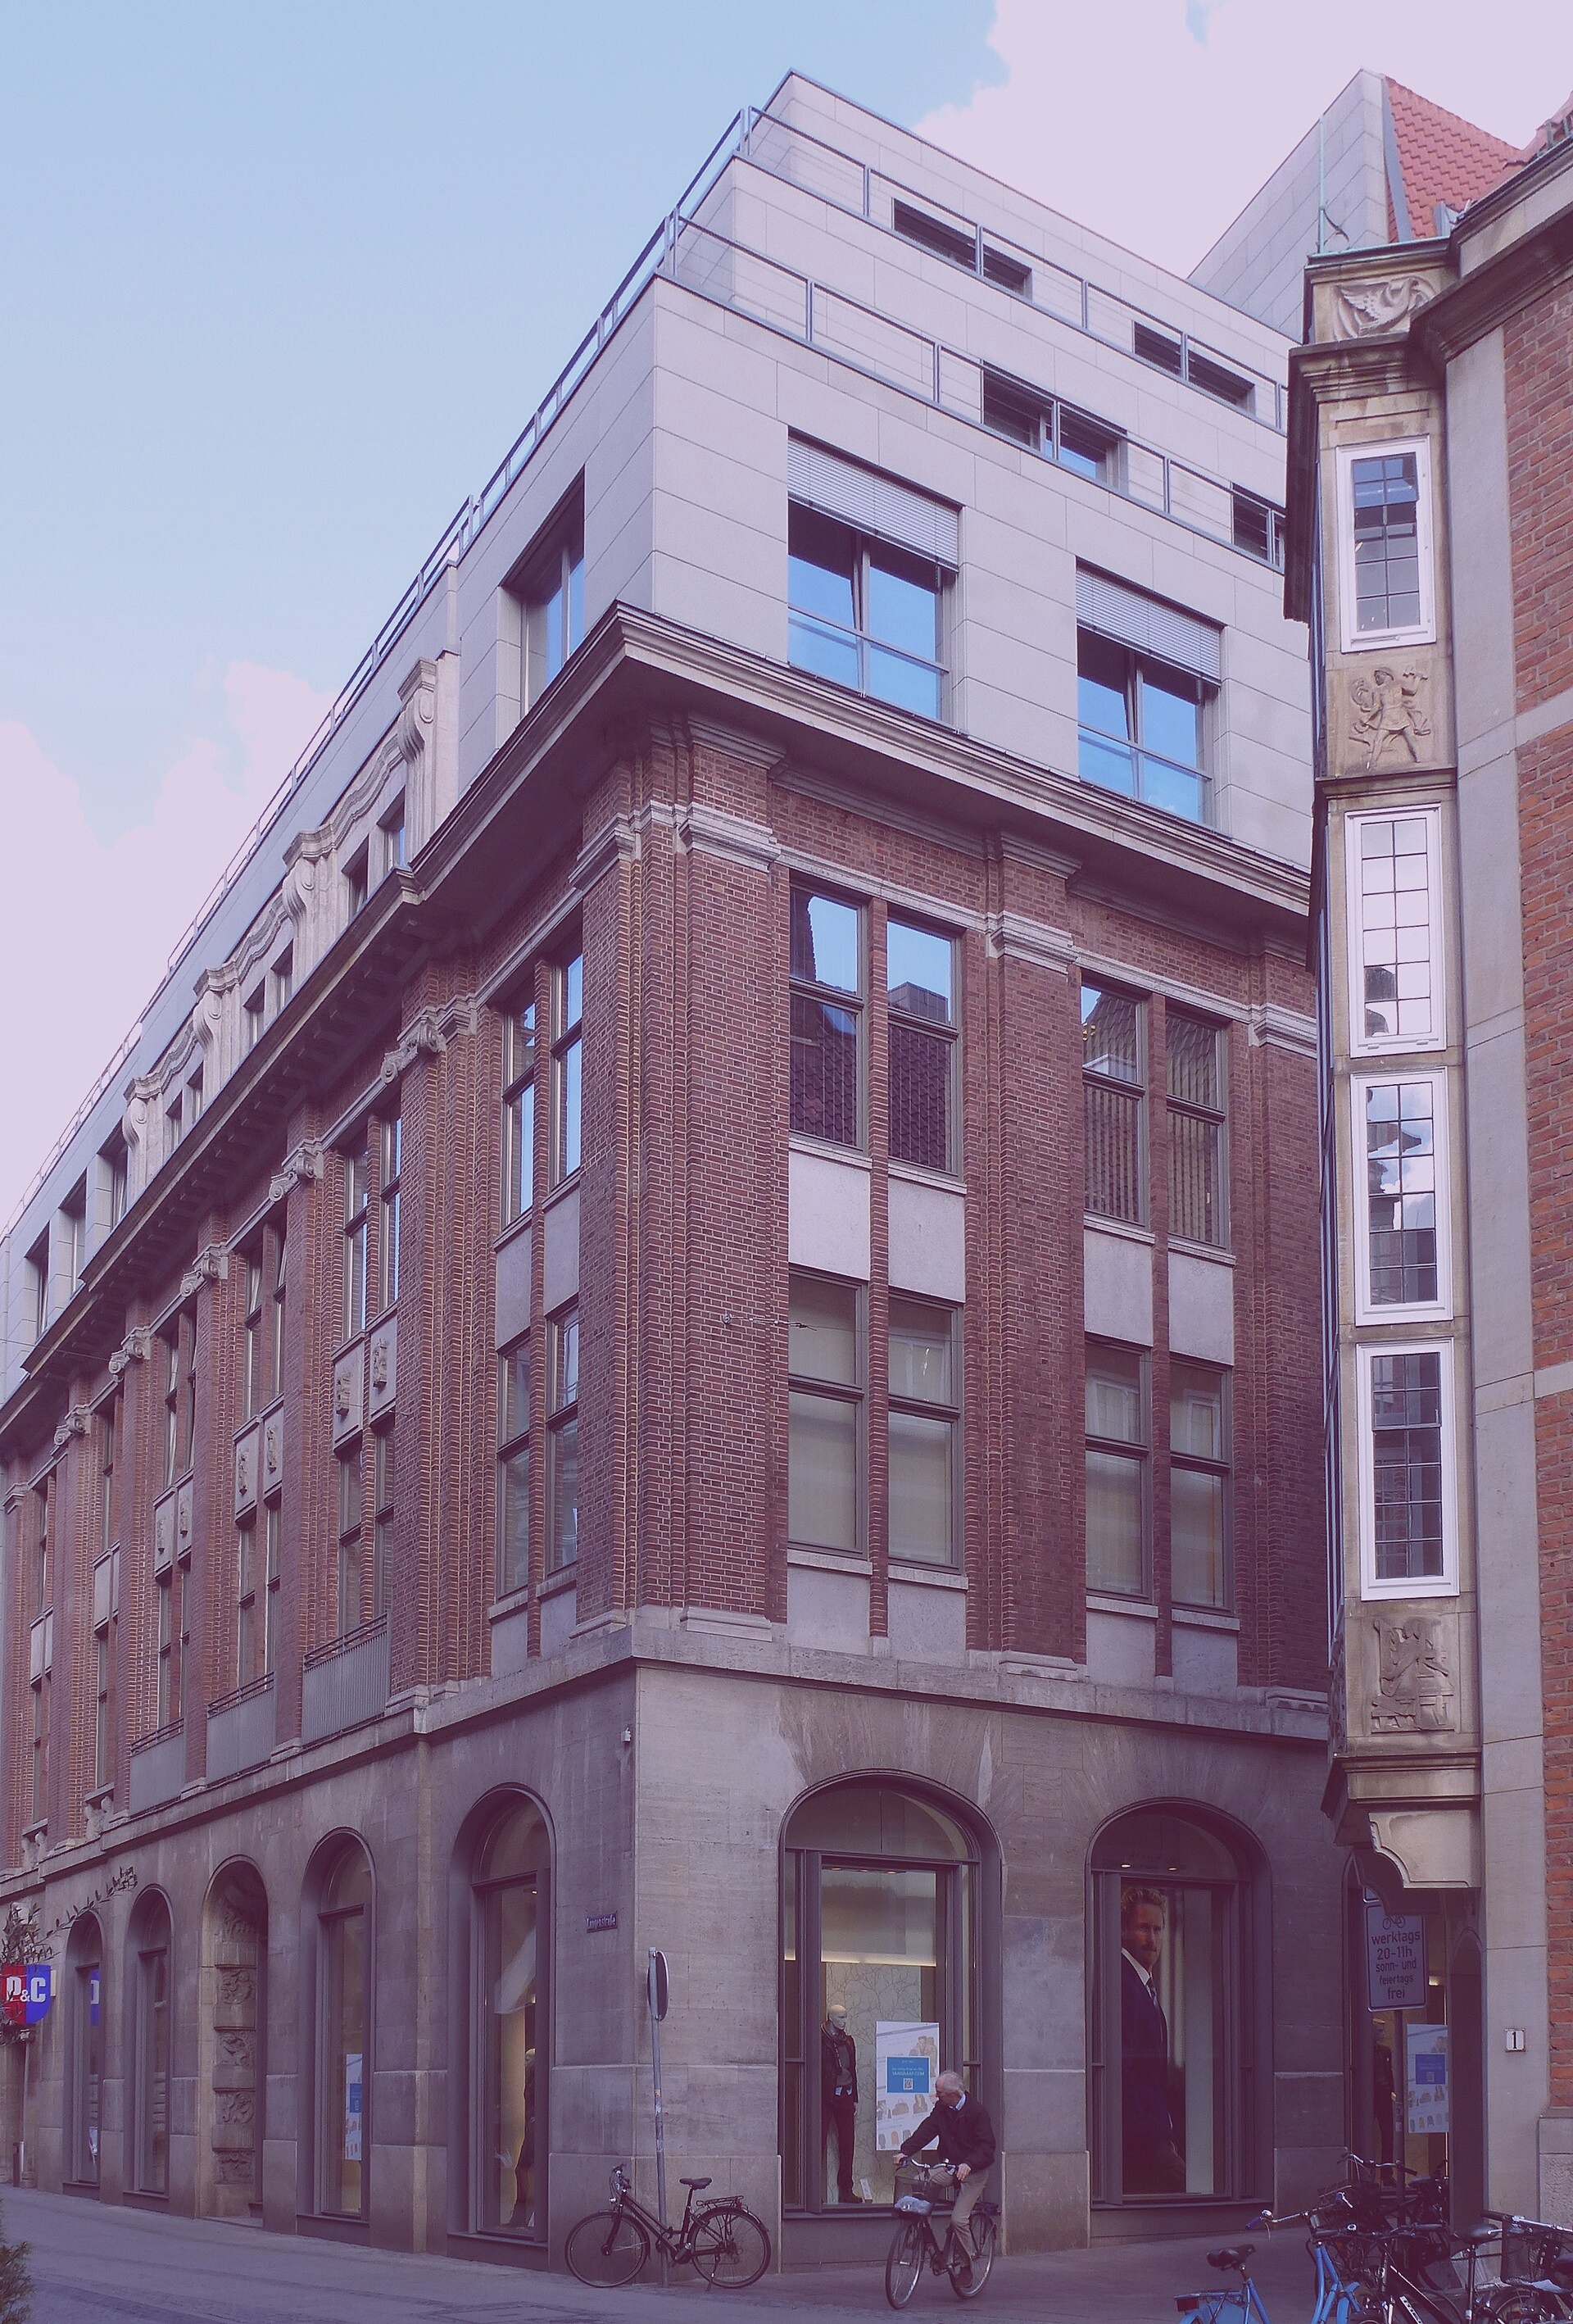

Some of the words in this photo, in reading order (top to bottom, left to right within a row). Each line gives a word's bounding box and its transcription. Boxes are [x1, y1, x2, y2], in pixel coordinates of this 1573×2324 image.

[1371, 1931, 1421, 1945] werktags
[1376, 1963, 1398, 1972] sonn-
[1402, 1957, 1417, 1970] und
[1379, 1974, 1414, 1985] feiertags
[1387, 1986, 1405, 1999] frei
[1512, 2031, 1517, 2049] 1
